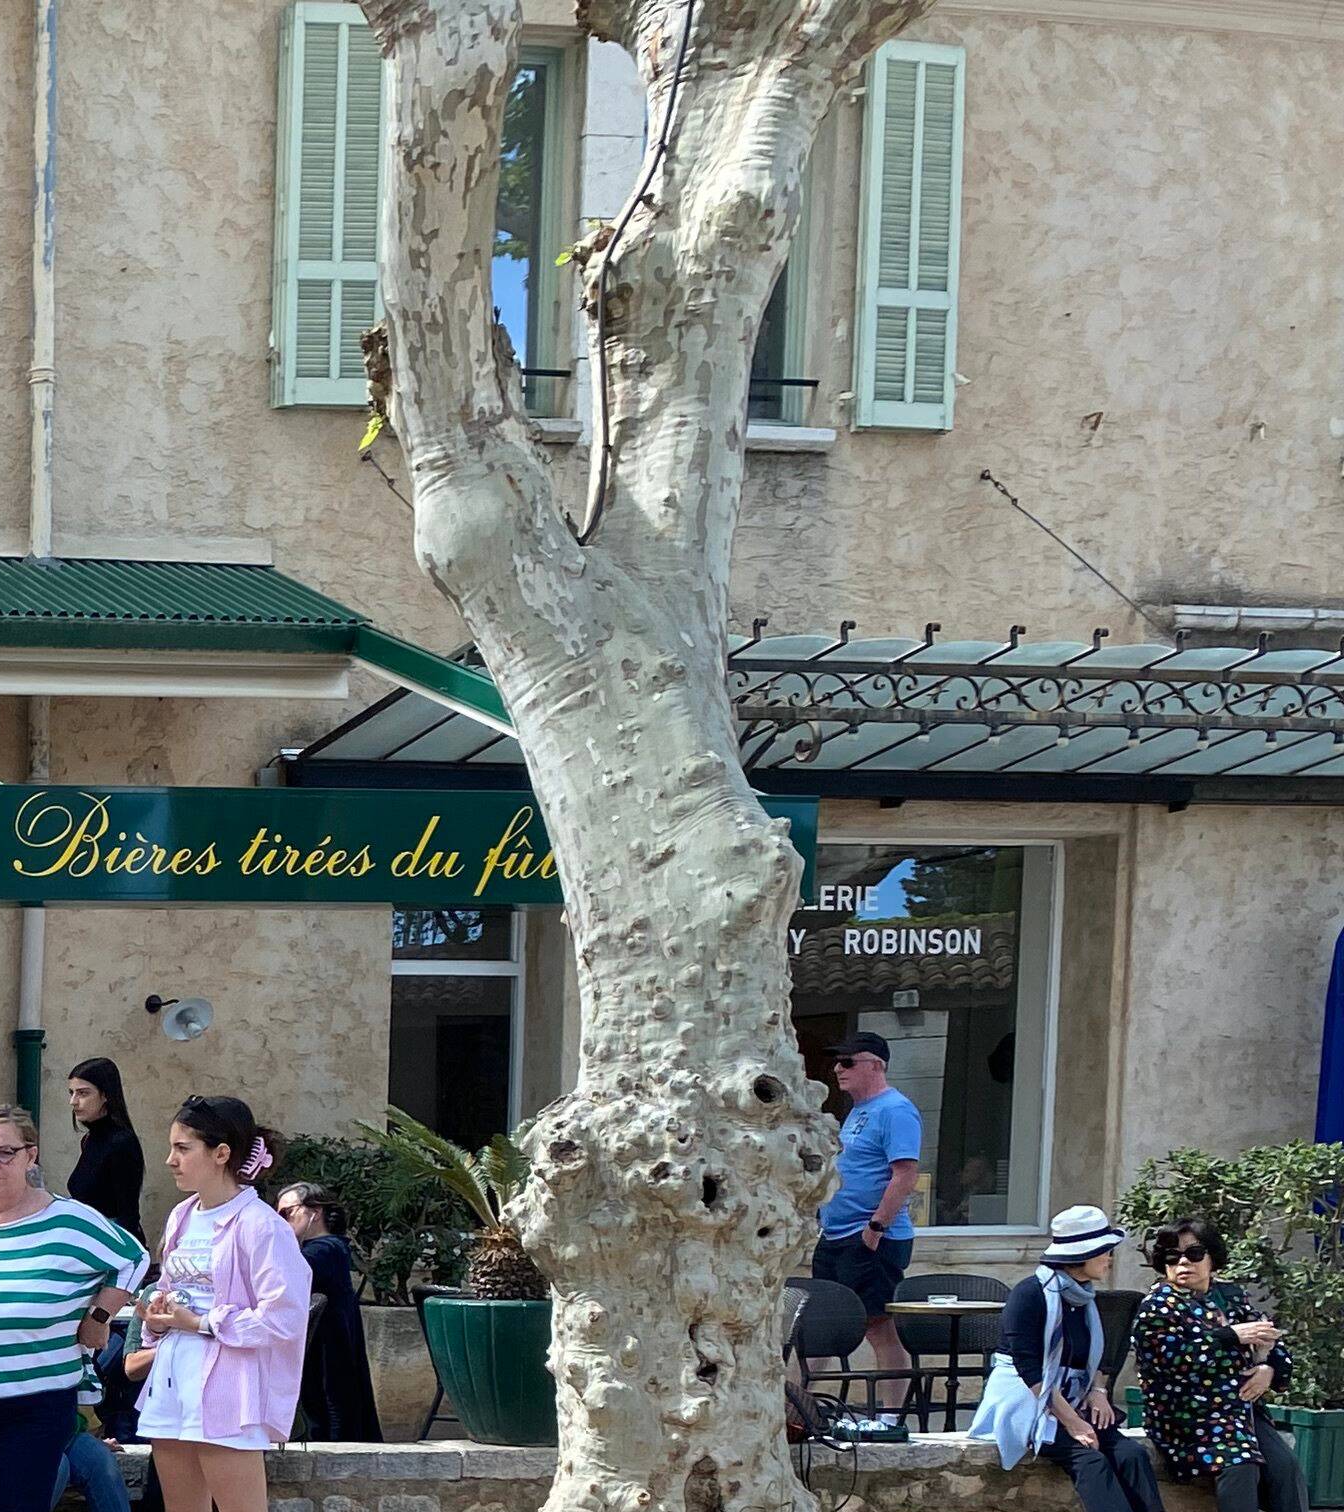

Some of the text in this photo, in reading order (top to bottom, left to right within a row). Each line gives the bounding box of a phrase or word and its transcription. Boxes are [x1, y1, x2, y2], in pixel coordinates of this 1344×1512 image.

[12, 791, 219, 877] Bières
[239, 828, 375, 876] tirées
[391, 815, 464, 878] du
[843, 928, 982, 955] ROBINSON
